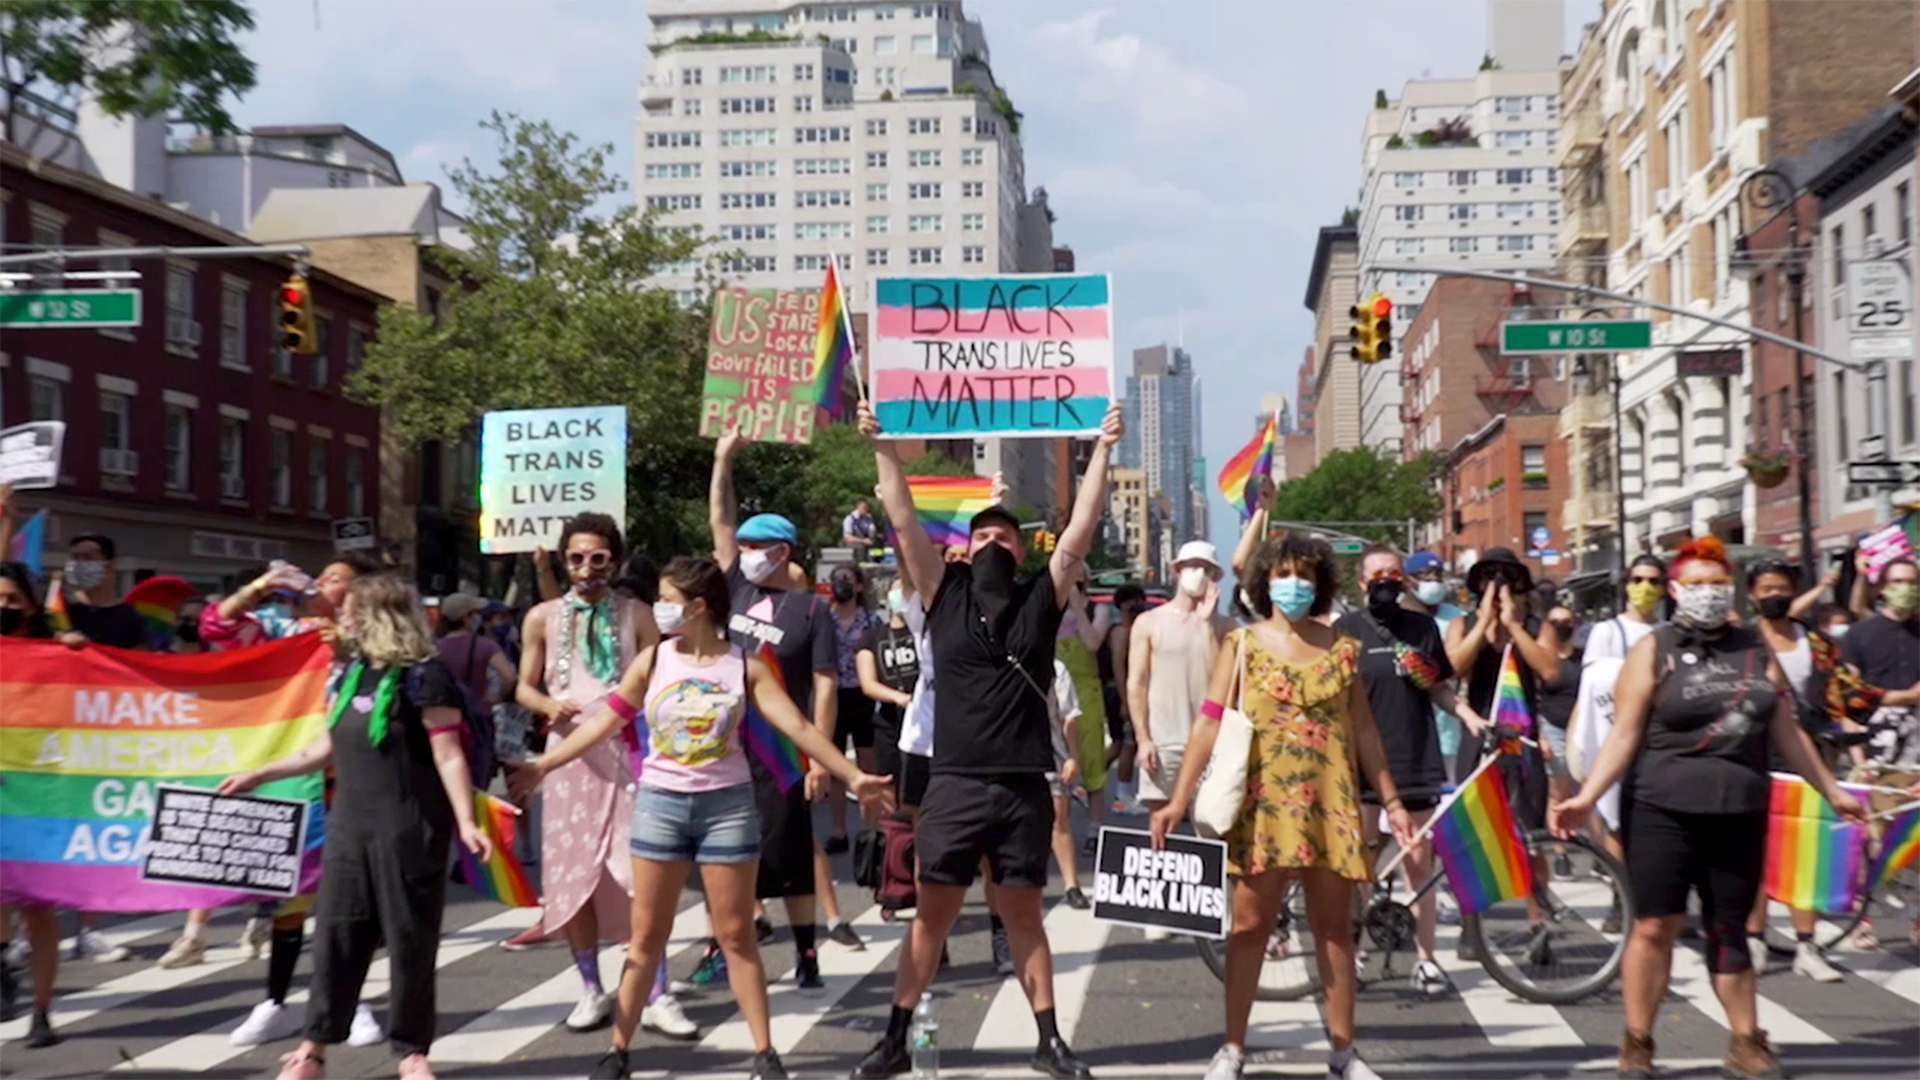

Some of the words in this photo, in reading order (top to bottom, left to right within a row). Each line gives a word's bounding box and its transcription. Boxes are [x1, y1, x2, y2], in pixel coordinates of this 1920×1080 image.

[28, 301, 45, 318] W
[775, 292, 819, 311] FED
[911, 282, 1078, 335] BLACK
[1858, 301, 1905, 326] 25
[716, 291, 770, 345] US
[767, 312, 819, 332] STATE
[1548, 329, 1563, 345] W
[1567, 329, 1584, 346] 10
[1588, 328, 1606, 345] St
[912, 340, 999, 371] TRANS
[1004, 340, 1075, 370] LIVES
[743, 378, 776, 400] ITS
[907, 375, 1083, 428] MATTER
[507, 418, 603, 441] BLACK
[699, 398, 810, 444] PEOPLE
[505, 450, 604, 472] TRANS
[512, 482, 596, 504] LIVES
[74, 690, 200, 725] MAKE
[35, 732, 237, 770] AMERICA
[93, 779, 160, 818] GA
[1123, 846, 1203, 884] DEFEND
[1096, 872, 1167, 910] BLACK
[1168, 881, 1224, 918] LIVES
